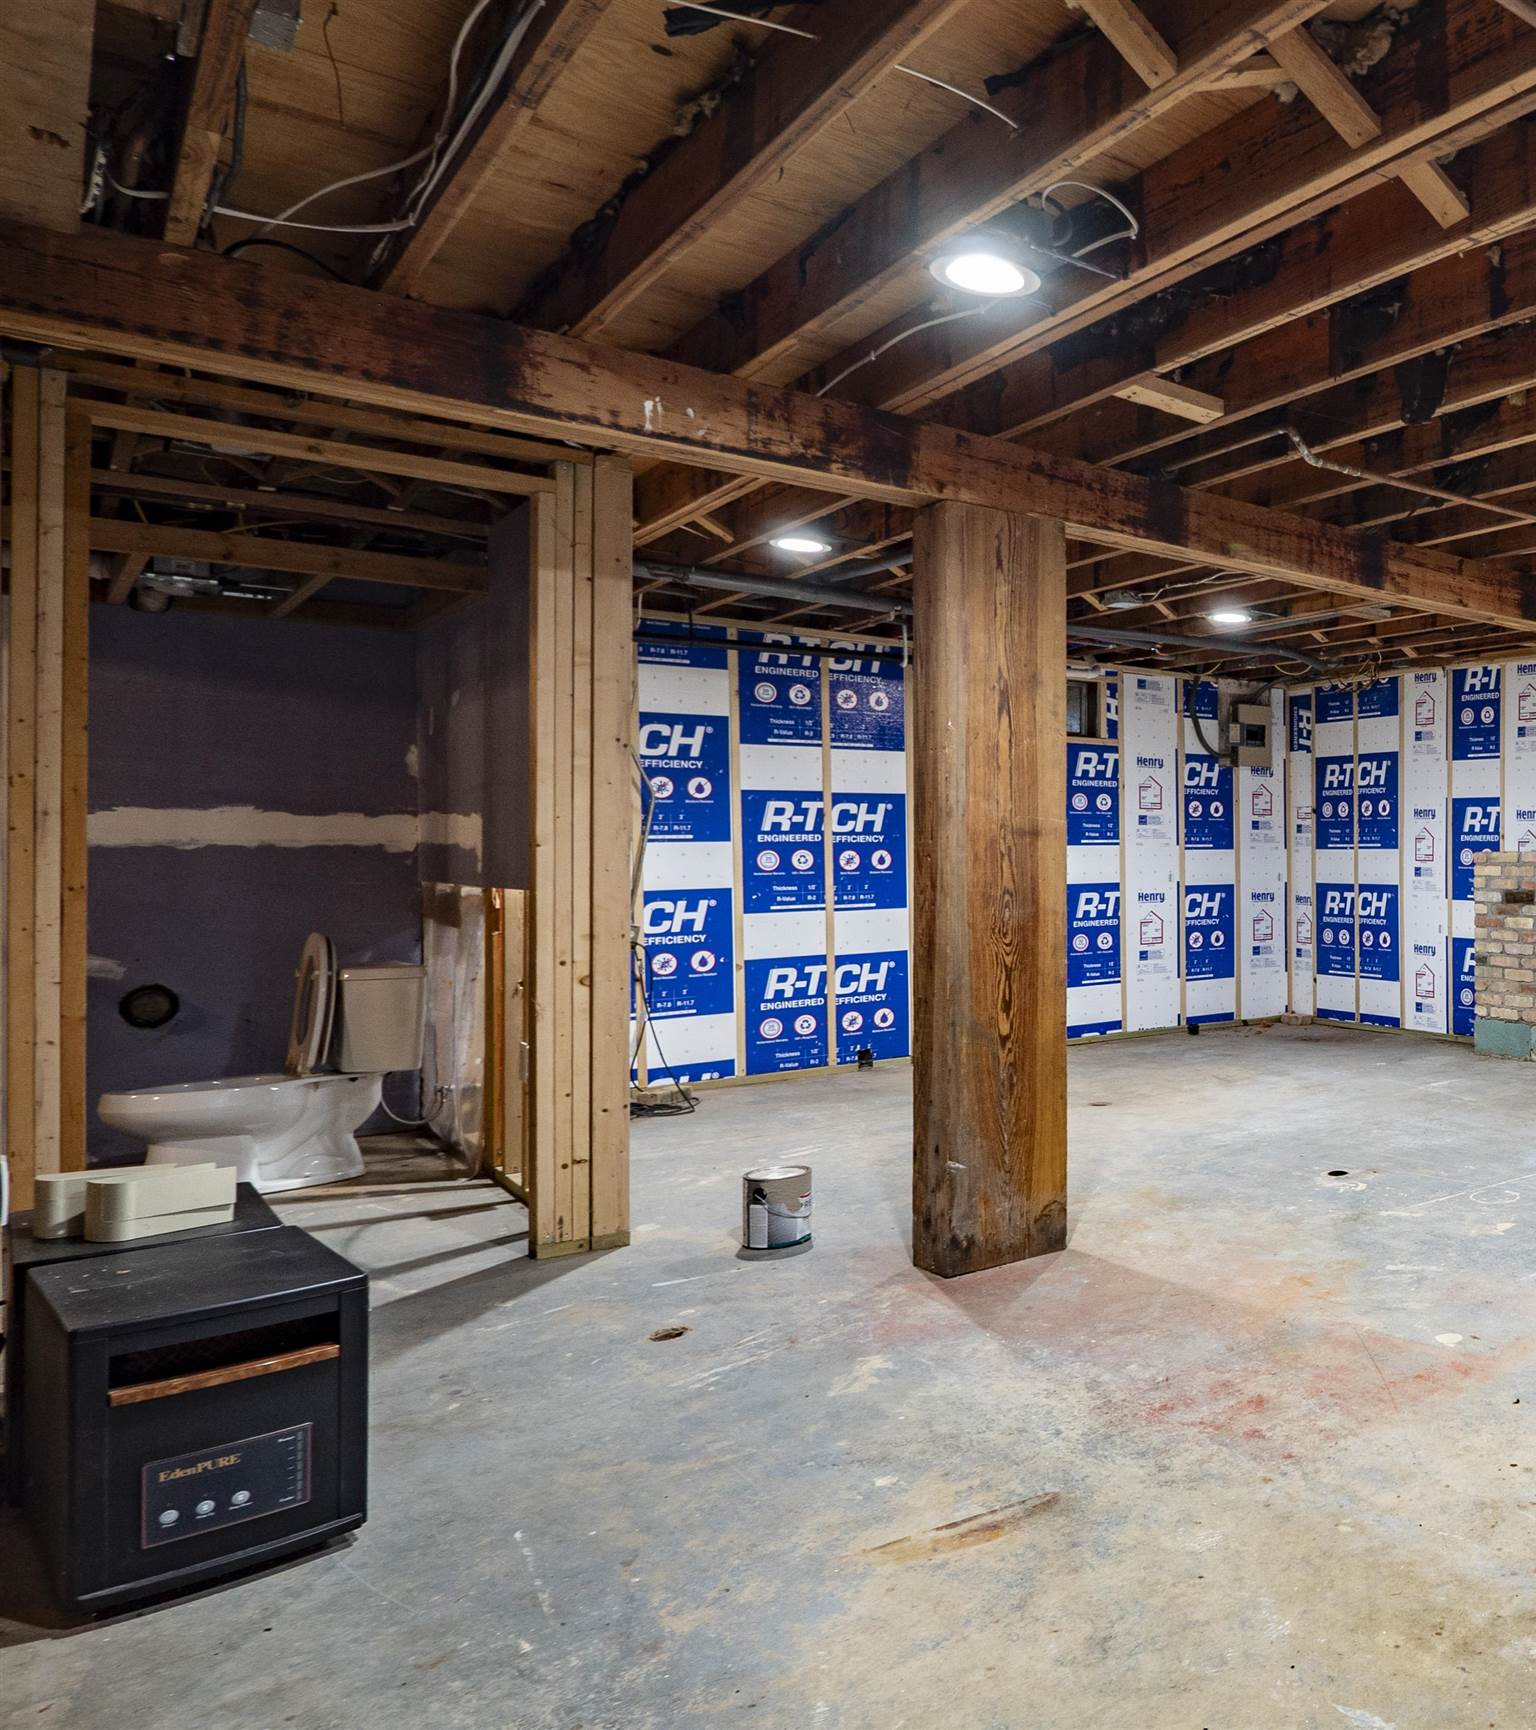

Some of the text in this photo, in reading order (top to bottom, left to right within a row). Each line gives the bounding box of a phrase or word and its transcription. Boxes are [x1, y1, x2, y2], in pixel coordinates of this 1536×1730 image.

[755, 666, 882, 684] ENGINEERED EFFICIENCY
[1414, 672, 1436, 682] Henry
[1461, 692, 1500, 702] ENGINEERED
[640, 760, 703, 769] EFFICIENCY
[1075, 752, 1119, 778] R-T
[1136, 756, 1163, 768] Henry
[1250, 766, 1273, 777] Henry
[1072, 779, 1117, 787] ENGINEERED
[1414, 808, 1436, 820] Henry
[757, 834, 884, 843] ENGINEERED EFFICIENCY
[1460, 834, 1499, 842] ENGINEERED
[1138, 892, 1165, 903] Henry
[1251, 892, 1274, 902] Henry
[1075, 892, 1120, 918] R-T
[1073, 919, 1118, 927] ENGINEERED
[643, 934, 706, 946] EFFICIENCY
[1414, 943, 1436, 956] Henry
[760, 993, 887, 1011] ENGINEERED EFFICIENCY
[159, 1453, 242, 1482] EdenPURE
